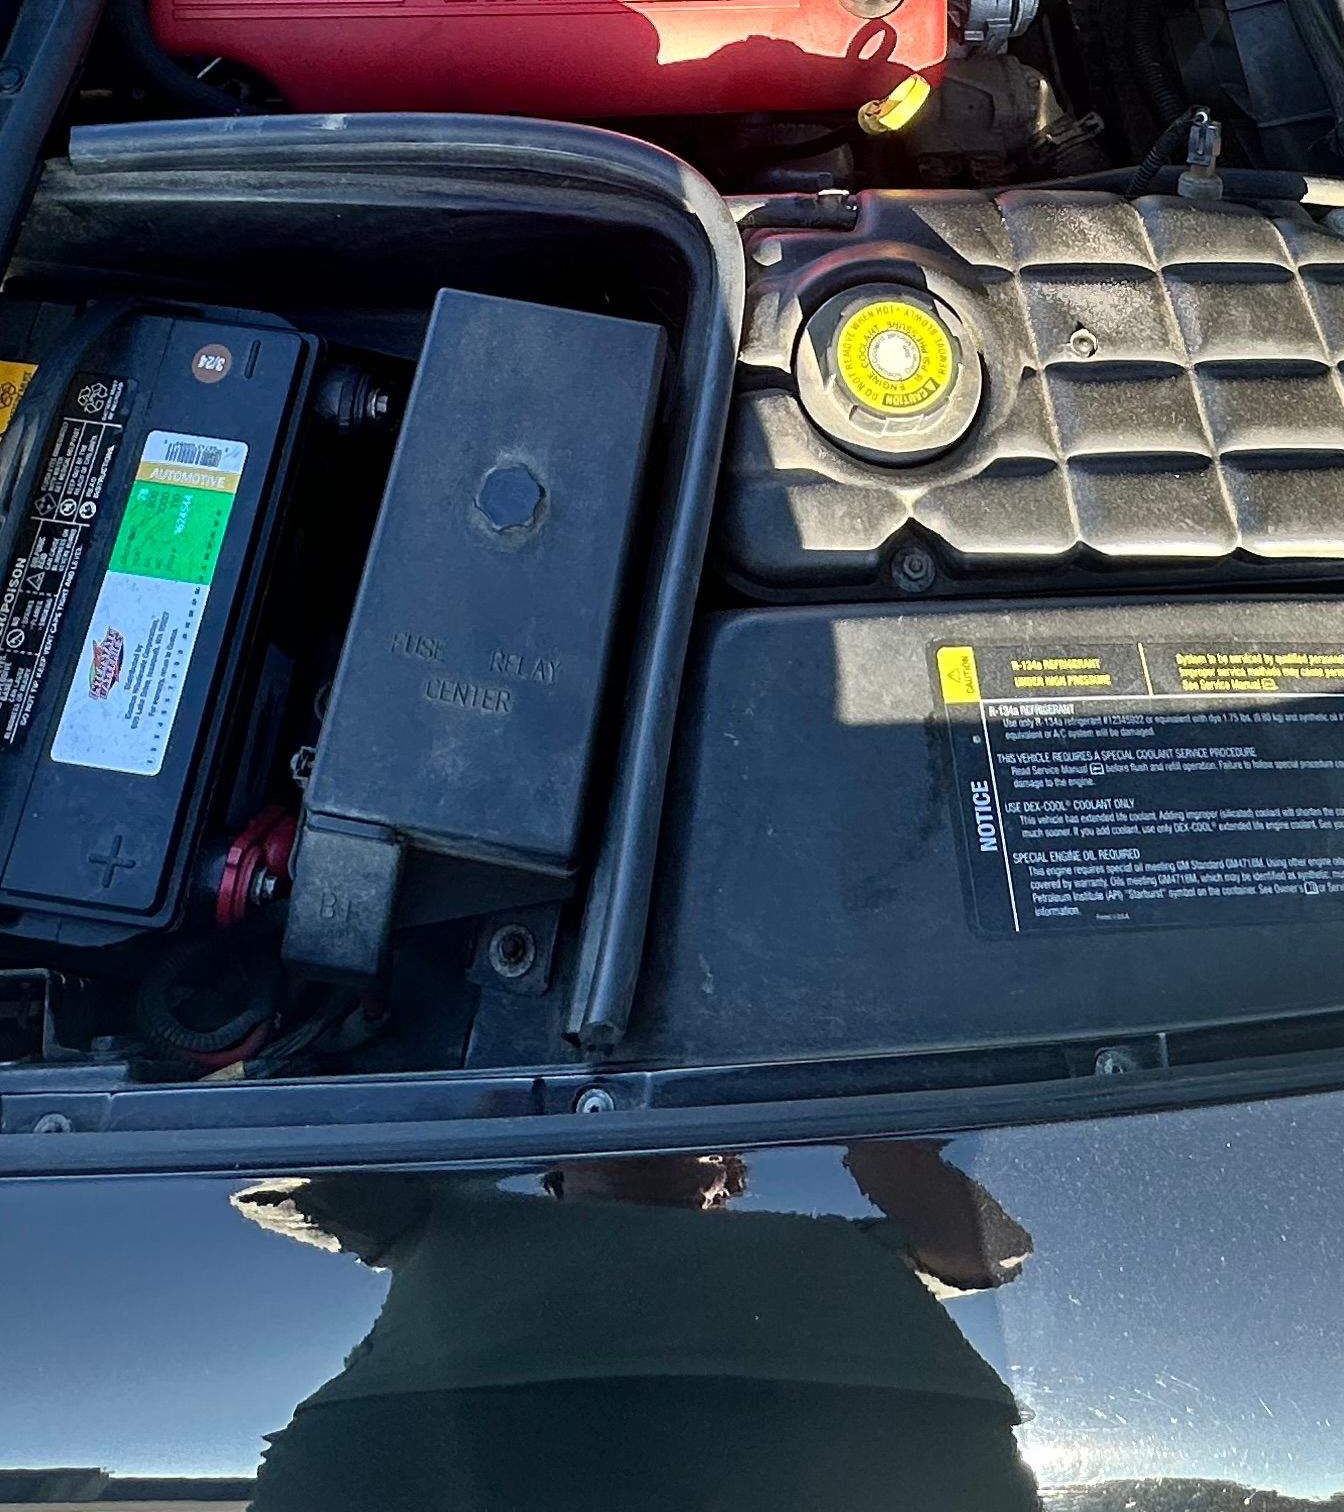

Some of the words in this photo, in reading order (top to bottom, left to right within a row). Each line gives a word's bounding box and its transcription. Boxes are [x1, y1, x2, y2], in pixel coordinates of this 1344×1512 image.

[848, 371, 865, 389] NOT
[149, 467, 227, 489] AUTOMOTIVE
[87, 627, 119, 698] INTERSTATE
[97, 633, 126, 698] BATTERIES
[489, 648, 560, 684] RELAY
[966, 655, 974, 694] CAUTION
[1011, 660, 1042, 670] R-134a
[424, 678, 512, 713] CENTER
[997, 753, 1016, 763] THIS
[1016, 752, 1051, 763] VEHICLE
[1052, 751, 1093, 762] REQUIRES
[1102, 750, 1134, 761] SPECIAL
[1136, 749, 1174, 760] COOLANT
[1175, 748, 1208, 759] SERVICE
[971, 780, 997, 851] NOTICE
[1005, 802, 1021, 813] USE
[1073, 798, 1113, 810] COOLANT
[1114, 798, 1135, 809] ONLY
[1012, 851, 1048, 864] SPECIAL
[1049, 850, 1081, 862] ENGINE
[1082, 849, 1097, 861] OIL
[1098, 848, 1140, 860] REQUIRED
